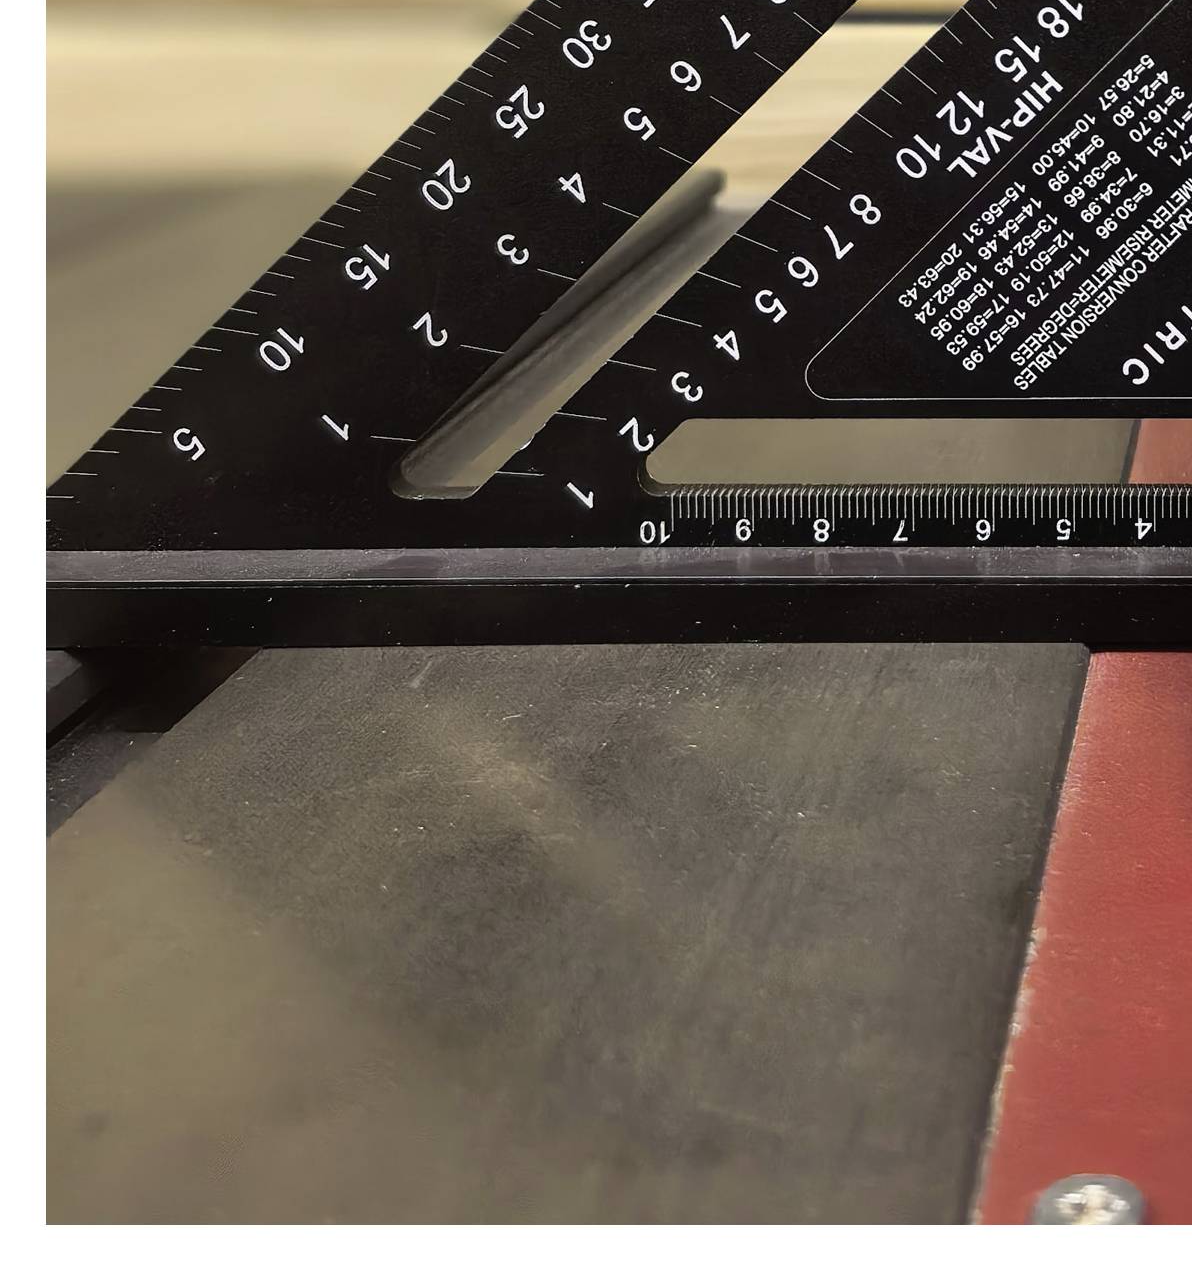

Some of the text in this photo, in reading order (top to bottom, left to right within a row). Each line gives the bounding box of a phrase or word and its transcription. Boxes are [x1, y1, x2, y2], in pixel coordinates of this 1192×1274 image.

[563, 20, 611, 68] 30
[720, 15, 751, 49] 7
[671, 61, 701, 91] 6
[995, 36, 1040, 82] 15
[496, 85, 544, 138] 25
[624, 108, 656, 140] 5
[936, 91, 984, 135] 12
[947, 71, 1063, 177] HIP-VAL
[896, 134, 940, 178] 10
[422, 159, 471, 210] 20
[559, 173, 586, 203] 4
[899, 55, 1154, 307] 5=26.57 10=45.00 15=56.31 20=63.43
[915, 71, 1168, 324] 4=21.80 9=41.99 14=54.46 19=62.24
[1081, 168, 1138, 222] 7=34.99
[850, 194, 881, 224] 8
[931, 86, 1185, 340] 3=16.70 8=38.66 13=52.43 18=60.95
[1096, 183, 1153, 239] 6=30.96
[497, 234, 529, 264] 3
[824, 225, 854, 259] 7
[345, 244, 389, 290] 15
[788, 257, 818, 287] 6
[1011, 230, 1073, 291] 12=50.19
[1027, 246, 1089, 307] 11=47.73
[755, 290, 787, 323] 5
[1011, 225, 1153, 366] RISE/METER=DEGREES
[1061, 260, 1146, 344] CONVERSION
[413, 312, 447, 346] 2
[947, 294, 1009, 355] 17=59.53
[963, 309, 1026, 370] 16=57.99
[260, 328, 303, 371] 10
[713, 330, 740, 360] 4
[1014, 341, 1067, 390] TABLES
[671, 372, 703, 402] 3
[174, 428, 205, 460] 5
[322, 415, 348, 440] 1
[619, 417, 654, 451] 2
[567, 483, 593, 508] 1
[640, 519, 671, 544] 10
[735, 518, 751, 541] 9
[813, 519, 830, 542] 8
[892, 519, 909, 541] 7
[976, 519, 991, 541] 6
[1056, 519, 1070, 541] 5
[1136, 519, 1153, 540] 4
